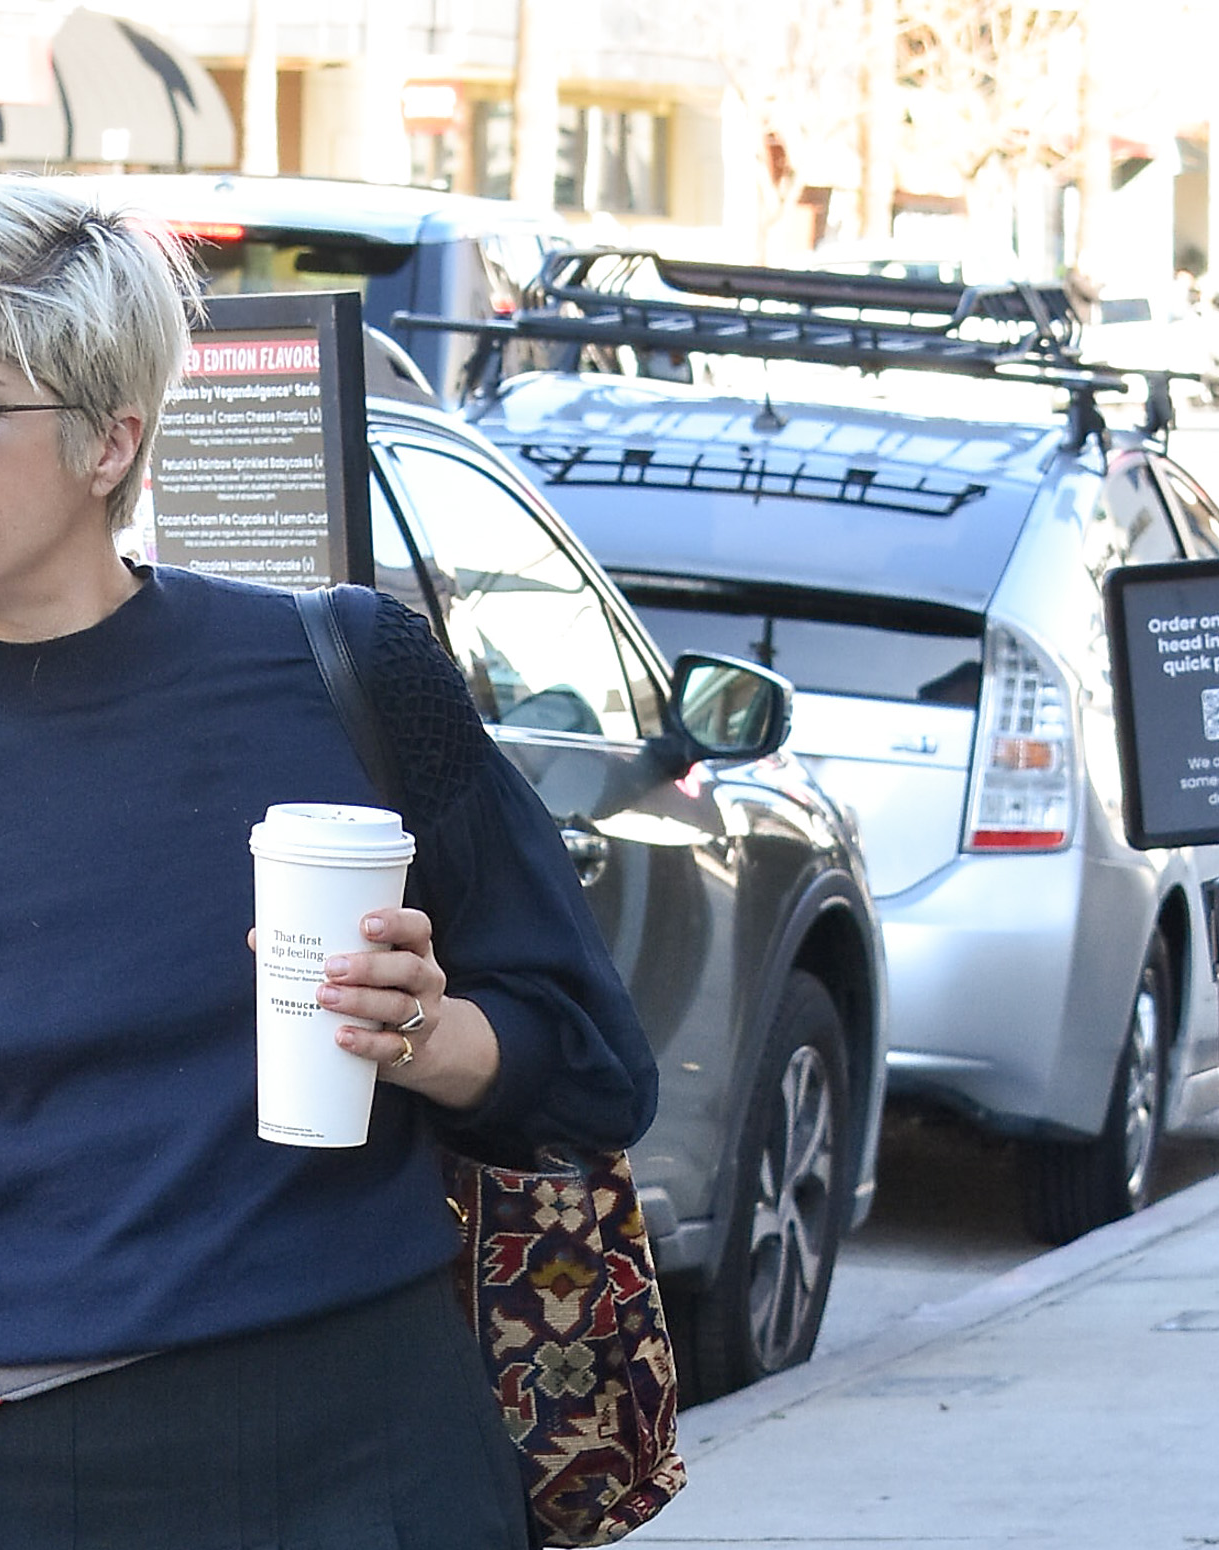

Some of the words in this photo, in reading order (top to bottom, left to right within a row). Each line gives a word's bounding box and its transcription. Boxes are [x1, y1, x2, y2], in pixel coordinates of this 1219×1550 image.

[203, 347, 257, 372] EDITION
[200, 385, 213, 404] by
[294, 381, 321, 397] Serie
[185, 411, 205, 425] Cake
[218, 411, 245, 424] Cream
[245, 410, 275, 423] Cheese
[270, 456, 313, 471] Babycakes
[157, 513, 190, 527] Coconut
[191, 513, 218, 526] Cream
[232, 513, 267, 528] Cupcake
[280, 512, 307, 525] Lemon
[308, 512, 328, 525] Curd
[189, 558, 229, 572] Chocolate
[265, 558, 301, 573] Cupcake
[1148, 616, 1197, 633] Order
[1158, 634, 1203, 653] head
[1163, 655, 1211, 678] quick
[1180, 776, 1218, 790] same
[273, 929, 296, 943] That
[299, 934, 322, 946] first
[271, 945, 285, 958] sip
[287, 946, 327, 962] feeling.
[270, 997, 322, 1011] STARBUCKS
[276, 1007, 313, 1018] REWARDS
